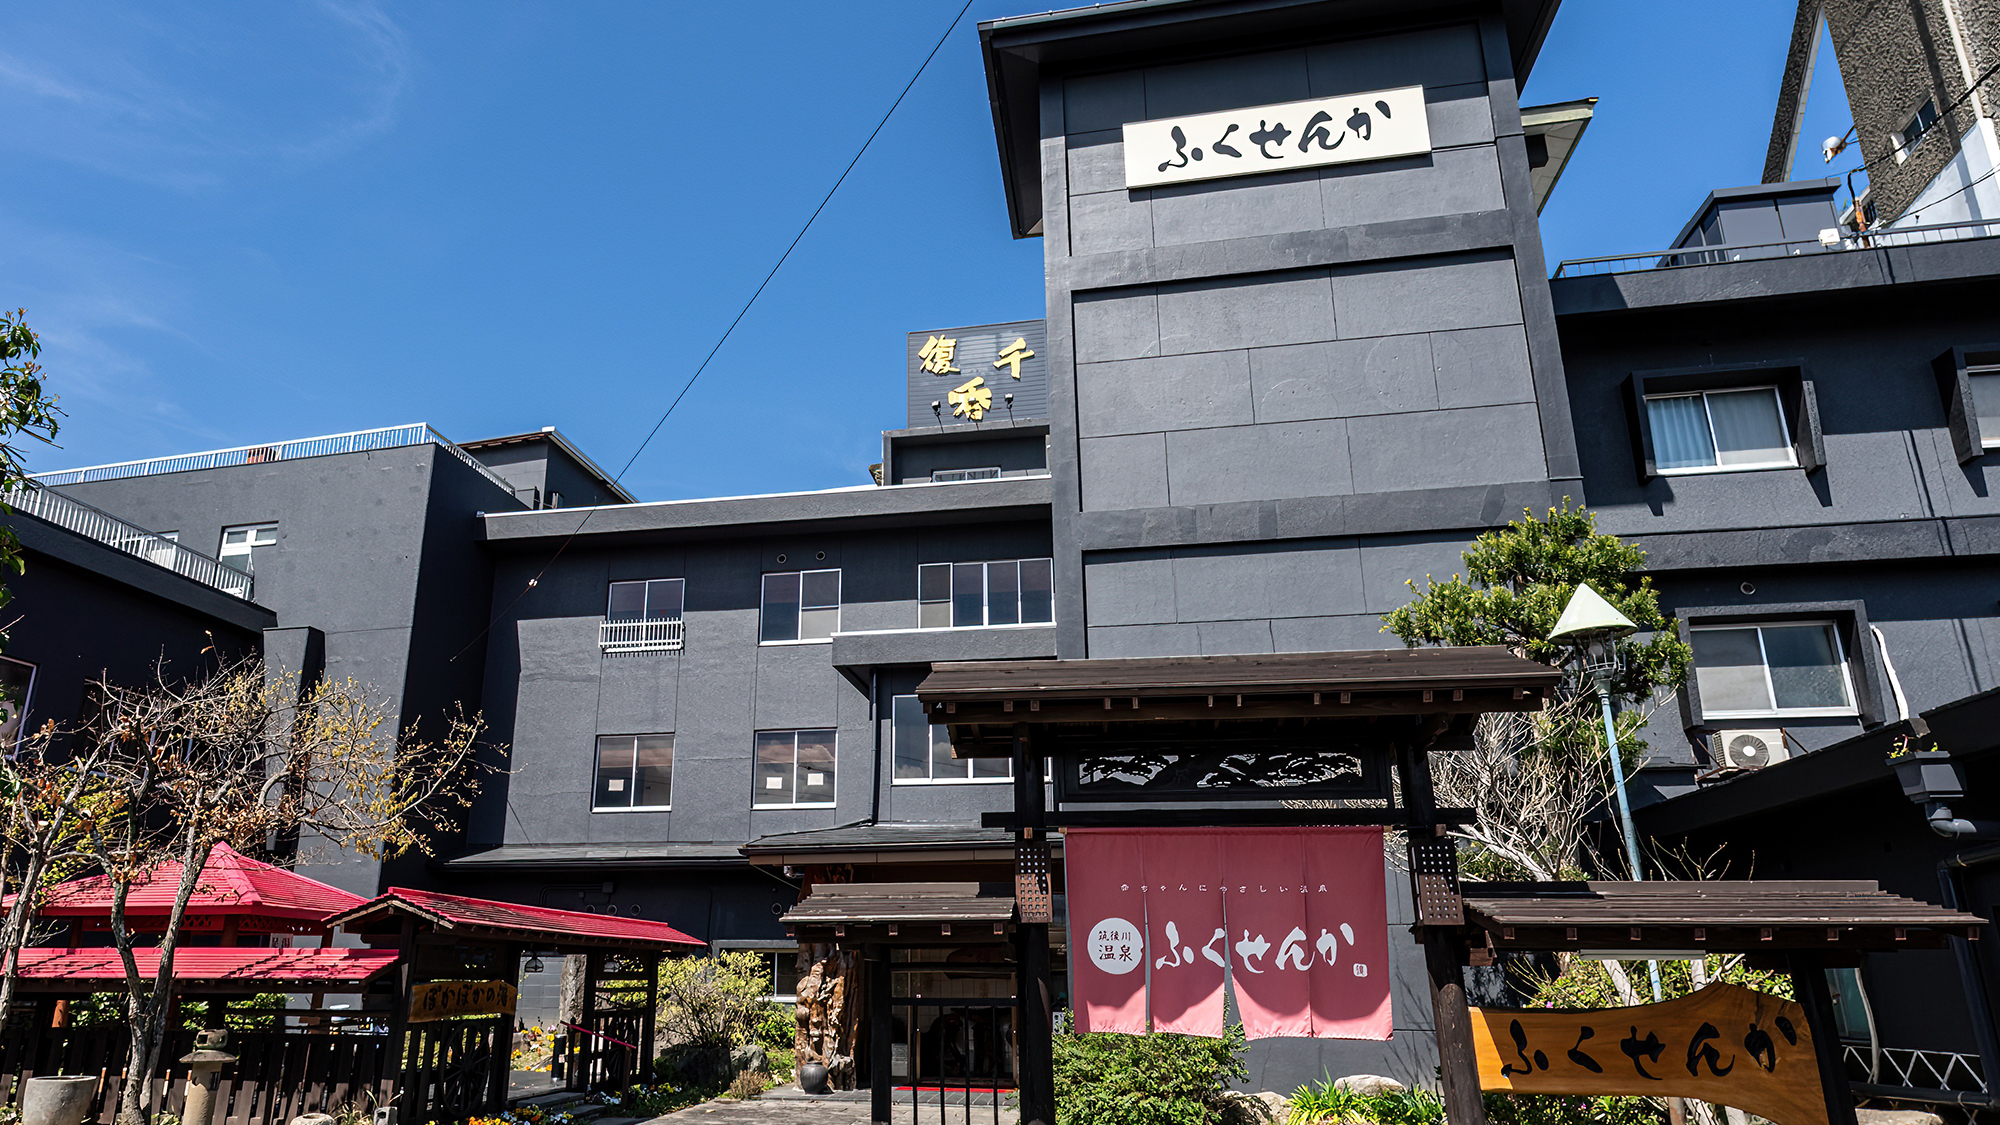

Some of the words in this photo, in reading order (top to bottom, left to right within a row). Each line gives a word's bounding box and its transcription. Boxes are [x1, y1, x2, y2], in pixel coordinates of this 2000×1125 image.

[1157, 99, 1392, 172] ふくせんか
[992, 336, 1035, 381] 千
[1098, 930, 1131, 942] 筑後川
[1098, 944, 1133, 962] 温泉
[1155, 920, 1355, 974] ふくせんか
[1500, 1016, 1797, 1081] ふくせんか
